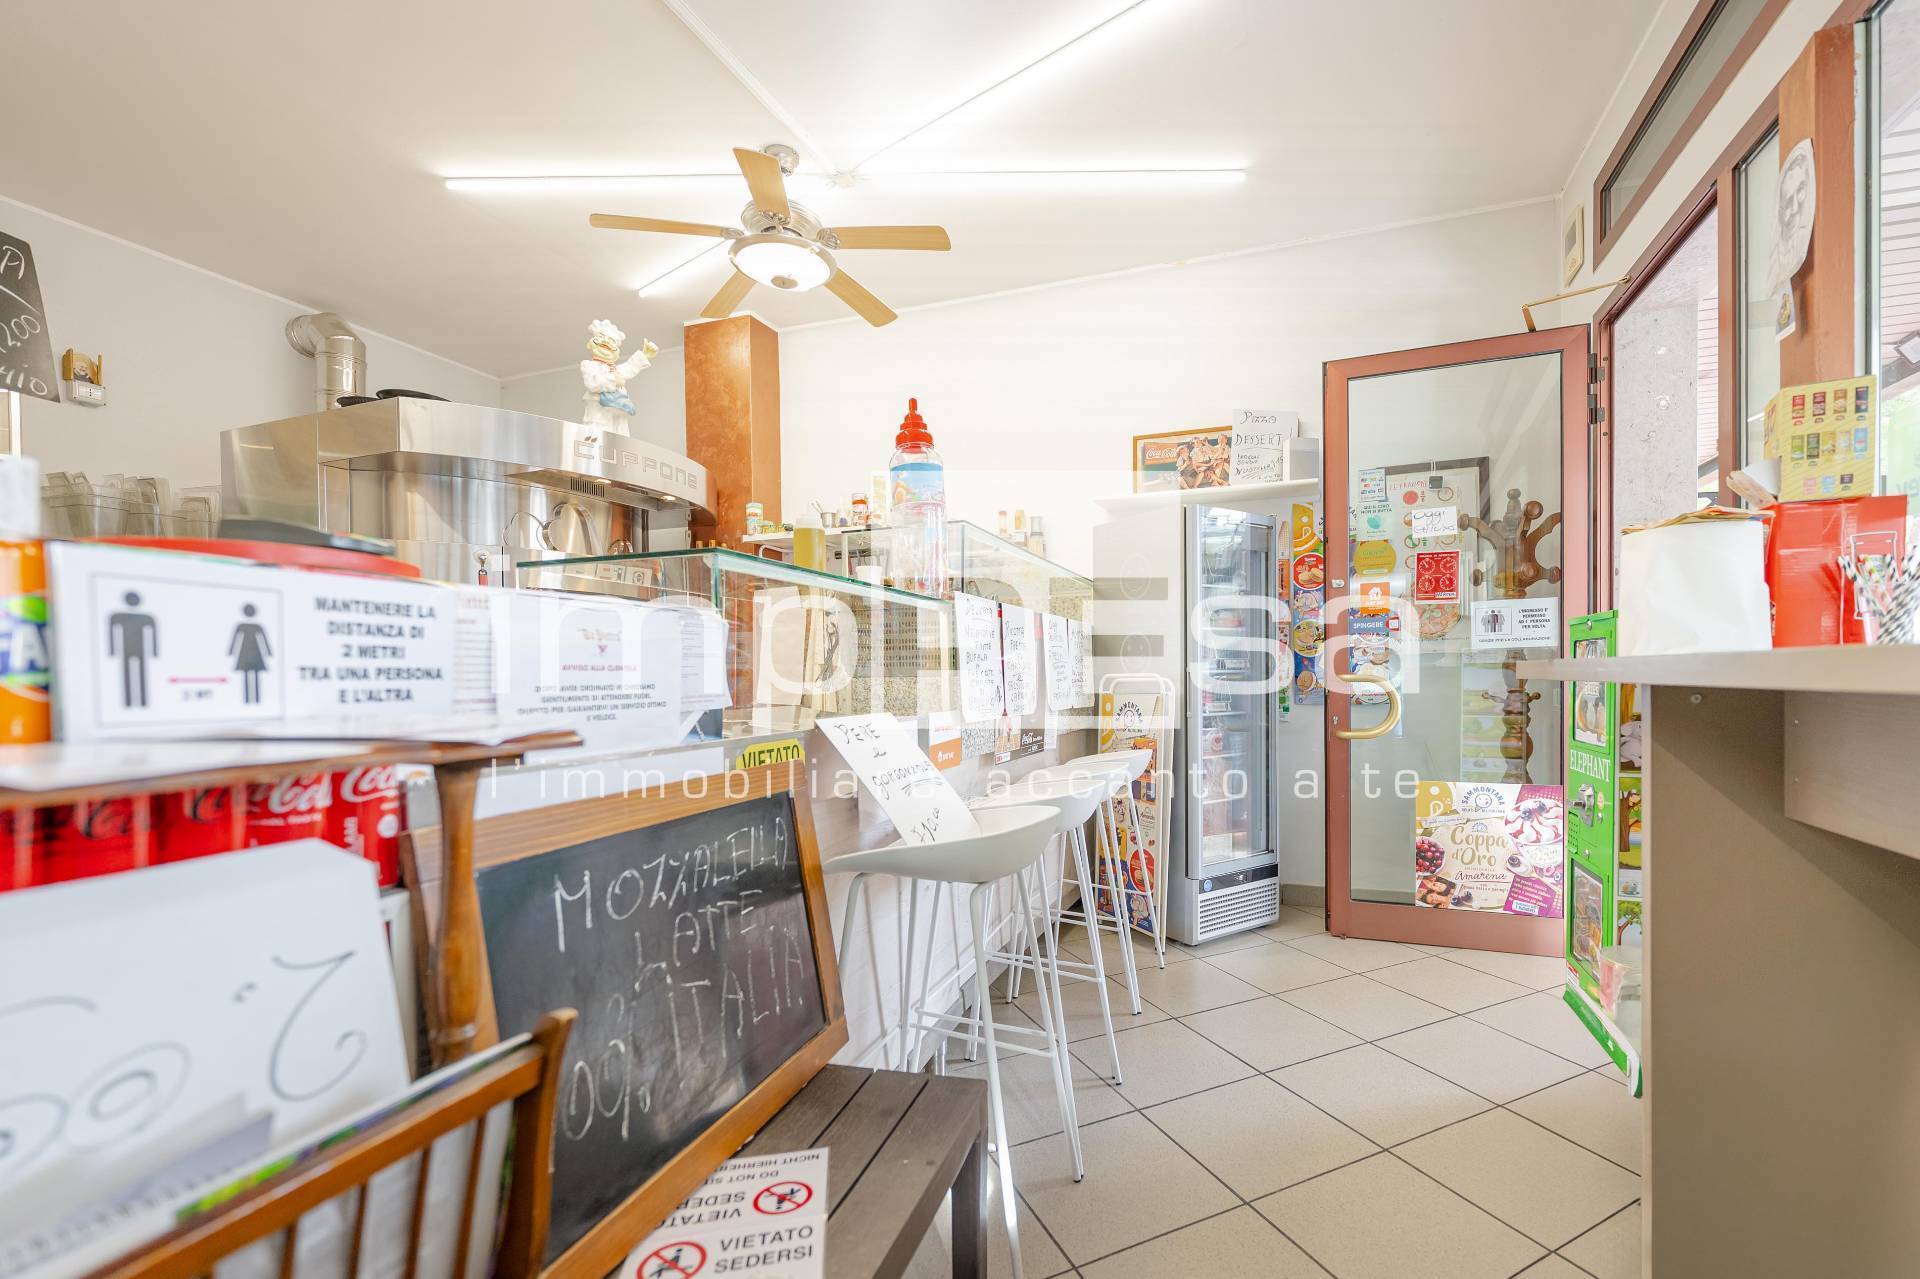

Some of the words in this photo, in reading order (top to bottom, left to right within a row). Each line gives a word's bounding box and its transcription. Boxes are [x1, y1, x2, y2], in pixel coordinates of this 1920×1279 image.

[314, 597, 413, 617] MANTENERE
[417, 604, 436, 618] LA
[327, 620, 405, 638] DISTANZA
[410, 625, 424, 639] DI
[1353, 621, 1384, 629] SPINGERE
[342, 644, 353, 658] 2
[357, 644, 406, 659] METRI
[298, 665, 331, 681] TRA
[336, 666, 369, 681] UNA
[374, 666, 443, 681] PERSONA
[338, 688, 348, 703] E
[353, 688, 413, 703] L'ALTRA
[742, 744, 800, 768] VIETATO
[1569, 749, 1611, 782] ELEPHANT
[1461, 785, 1506, 806] SAMMONTANA
[1450, 825, 1509, 852] Coppa
[1451, 846, 1497, 866] d'Oro
[1454, 870, 1508, 881] Amarena
[782, 1152, 820, 1166] NICHT
[729, 1174, 756, 1184] NOT
[759, 1170, 780, 1179] DO
[676, 1191, 747, 1211] SEDER
[720, 1225, 814, 1252] VIETATO
[713, 1245, 813, 1274] SEDERSI
